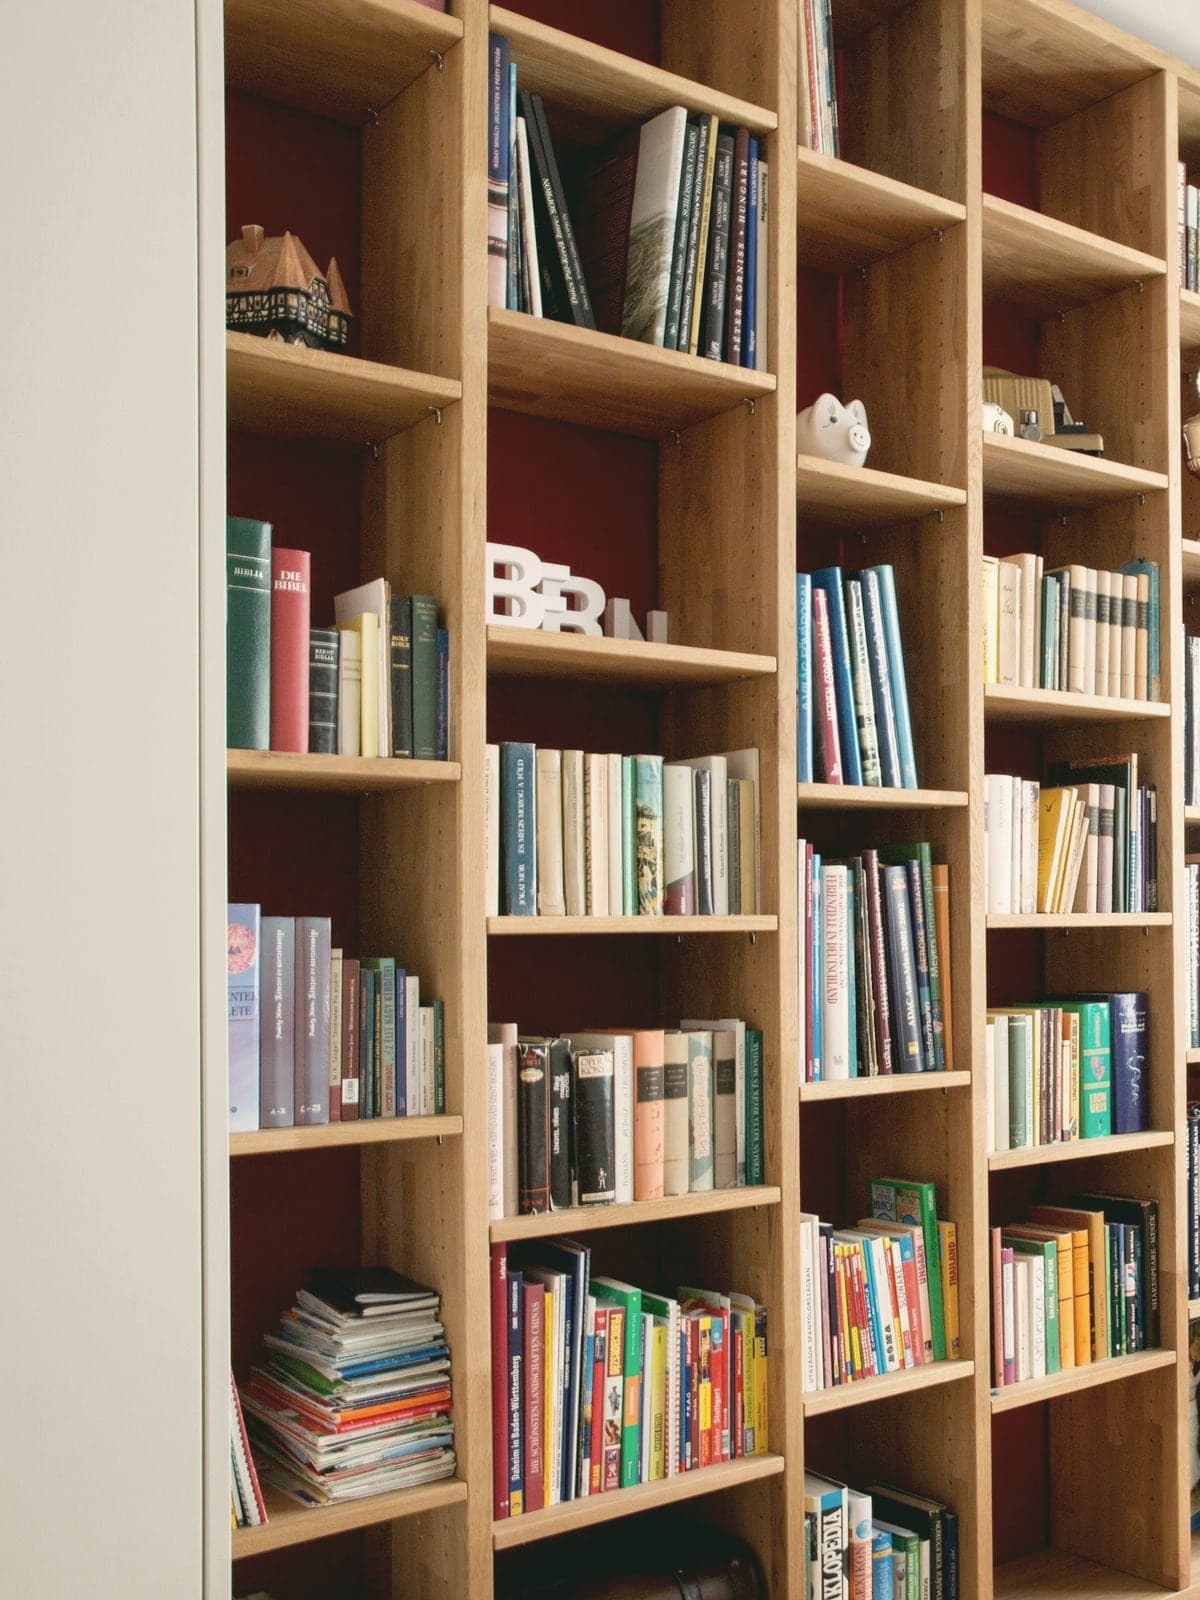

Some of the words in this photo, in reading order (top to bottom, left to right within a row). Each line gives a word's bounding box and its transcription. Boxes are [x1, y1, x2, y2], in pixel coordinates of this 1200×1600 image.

[687, 130, 697, 162] UNGARN
[698, 125, 708, 150] UNGARN
[542, 176, 557, 214] SOPRON
[681, 172, 694, 217] SCHLÖSSER
[694, 159, 706, 202] SCHLÖSSER
[738, 159, 748, 224] HUNGARY
[735, 242, 745, 301] KORNISS
[733, 308, 742, 352] PÉTER
[274, 580, 308, 593] BIBEL
[280, 570, 304, 582] DIE
[799, 584, 808, 659] FŐVÁROSAI
[800, 662, 809, 700] VILÁG
[516, 758, 524, 780] FÖLD
[517, 790, 525, 818] MOZOG
[518, 864, 526, 883] MÓR
[518, 884, 526, 905] JÓKAI
[826, 875, 838, 929] FERIENZIELE
[912, 866, 924, 924] WELTATLAS
[924, 860, 936, 938] Universalatlas
[917, 928, 928, 973] DIERCKE
[928, 939, 939, 978] Meyers
[826, 943, 839, 1005] DEUTSCHLAND
[383, 1002, 393, 1025] NAGY
[905, 996, 916, 1027] ADAC
[924, 1000, 936, 1066] westermann
[751, 1041, 760, 1077] MONDÁK
[751, 1078, 759, 1088] ÉS
[752, 1090, 760, 1116] REGÉK
[499, 1257, 507, 1280] Leipzig
[916, 1244, 927, 1285] UNGARN
[948, 1240, 958, 1287] THAILAND
[1148, 1214, 1158, 1310] SHAKESPEARE-MESÉK
[864, 1287, 872, 1318] BLANCA
[895, 1264, 907, 1308] SLOWAKEI
[530, 1300, 540, 1334] CHINAS
[868, 1320, 876, 1349] COSTA
[884, 1324, 895, 1363] ROMA
[529, 1336, 540, 1403] LANDSCHAFTEN
[510, 1354, 522, 1438] Baden-Württemberg
[713, 1388, 721, 1424] Stuttgart
[529, 1405, 540, 1457] SCHÖNSTEN
[511, 1449, 521, 1481] Daheim
[530, 1459, 540, 1474] DIE
